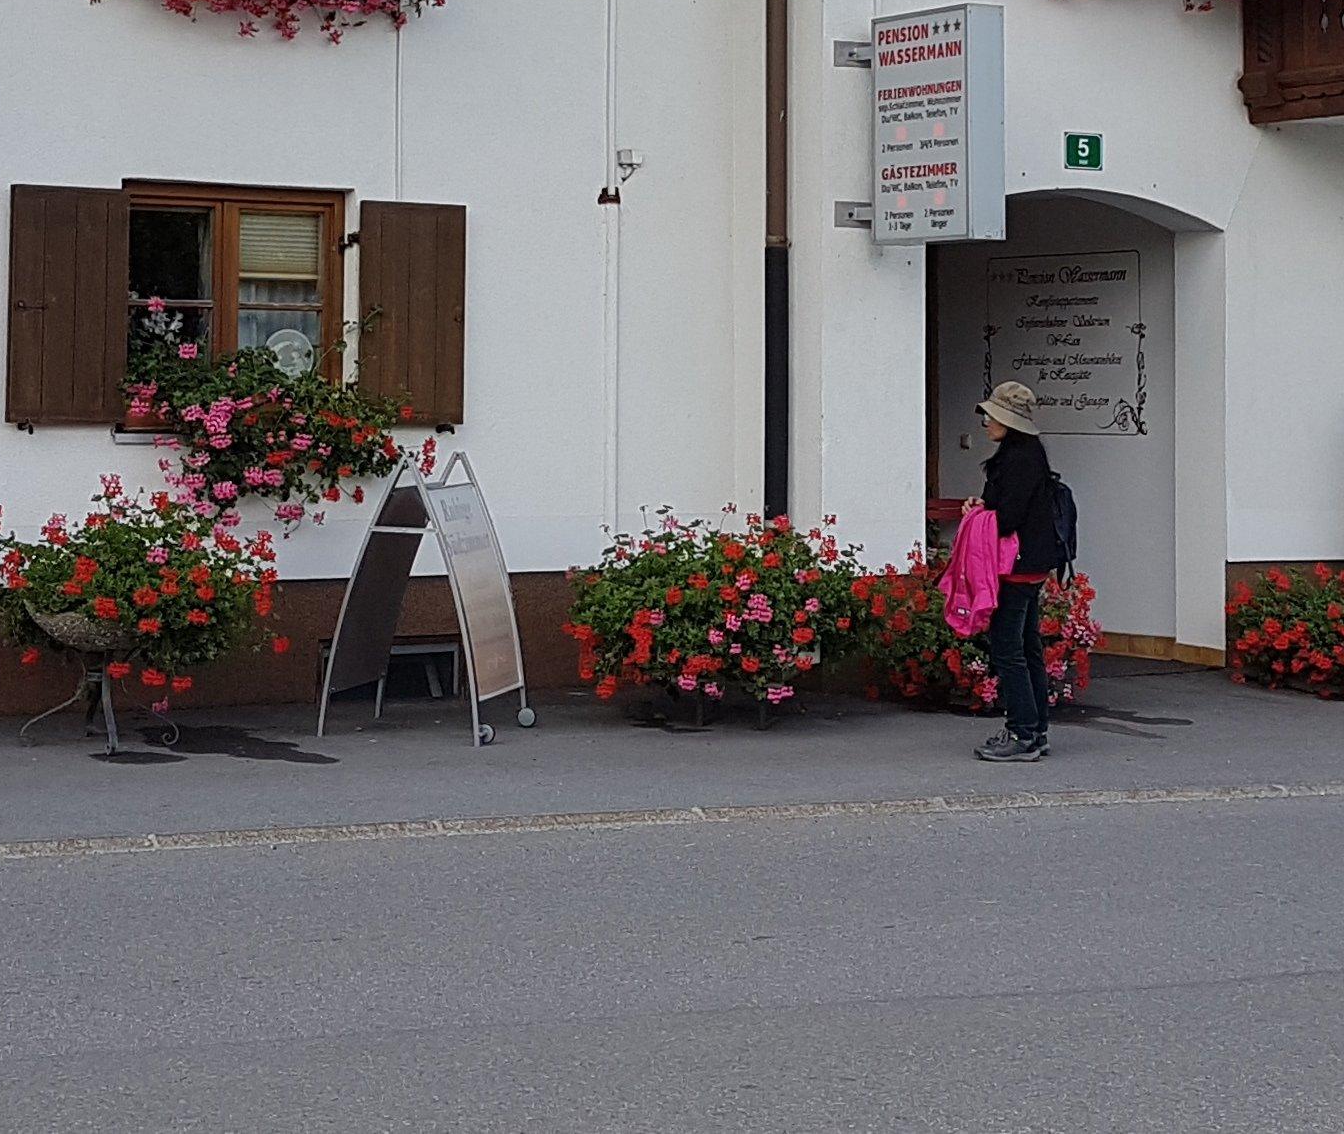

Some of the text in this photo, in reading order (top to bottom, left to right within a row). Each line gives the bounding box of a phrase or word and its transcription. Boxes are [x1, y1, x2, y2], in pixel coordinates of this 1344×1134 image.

[878, 23, 929, 45] PENSION
[878, 40, 962, 66] WASSERMANN
[878, 80, 962, 101] FERIENWOHNUNGEN
[949, 107, 959, 115] TV
[1077, 138, 1090, 157] 5
[881, 162, 958, 180] GÄSTEZIMMER
[949, 178, 959, 186] TV
